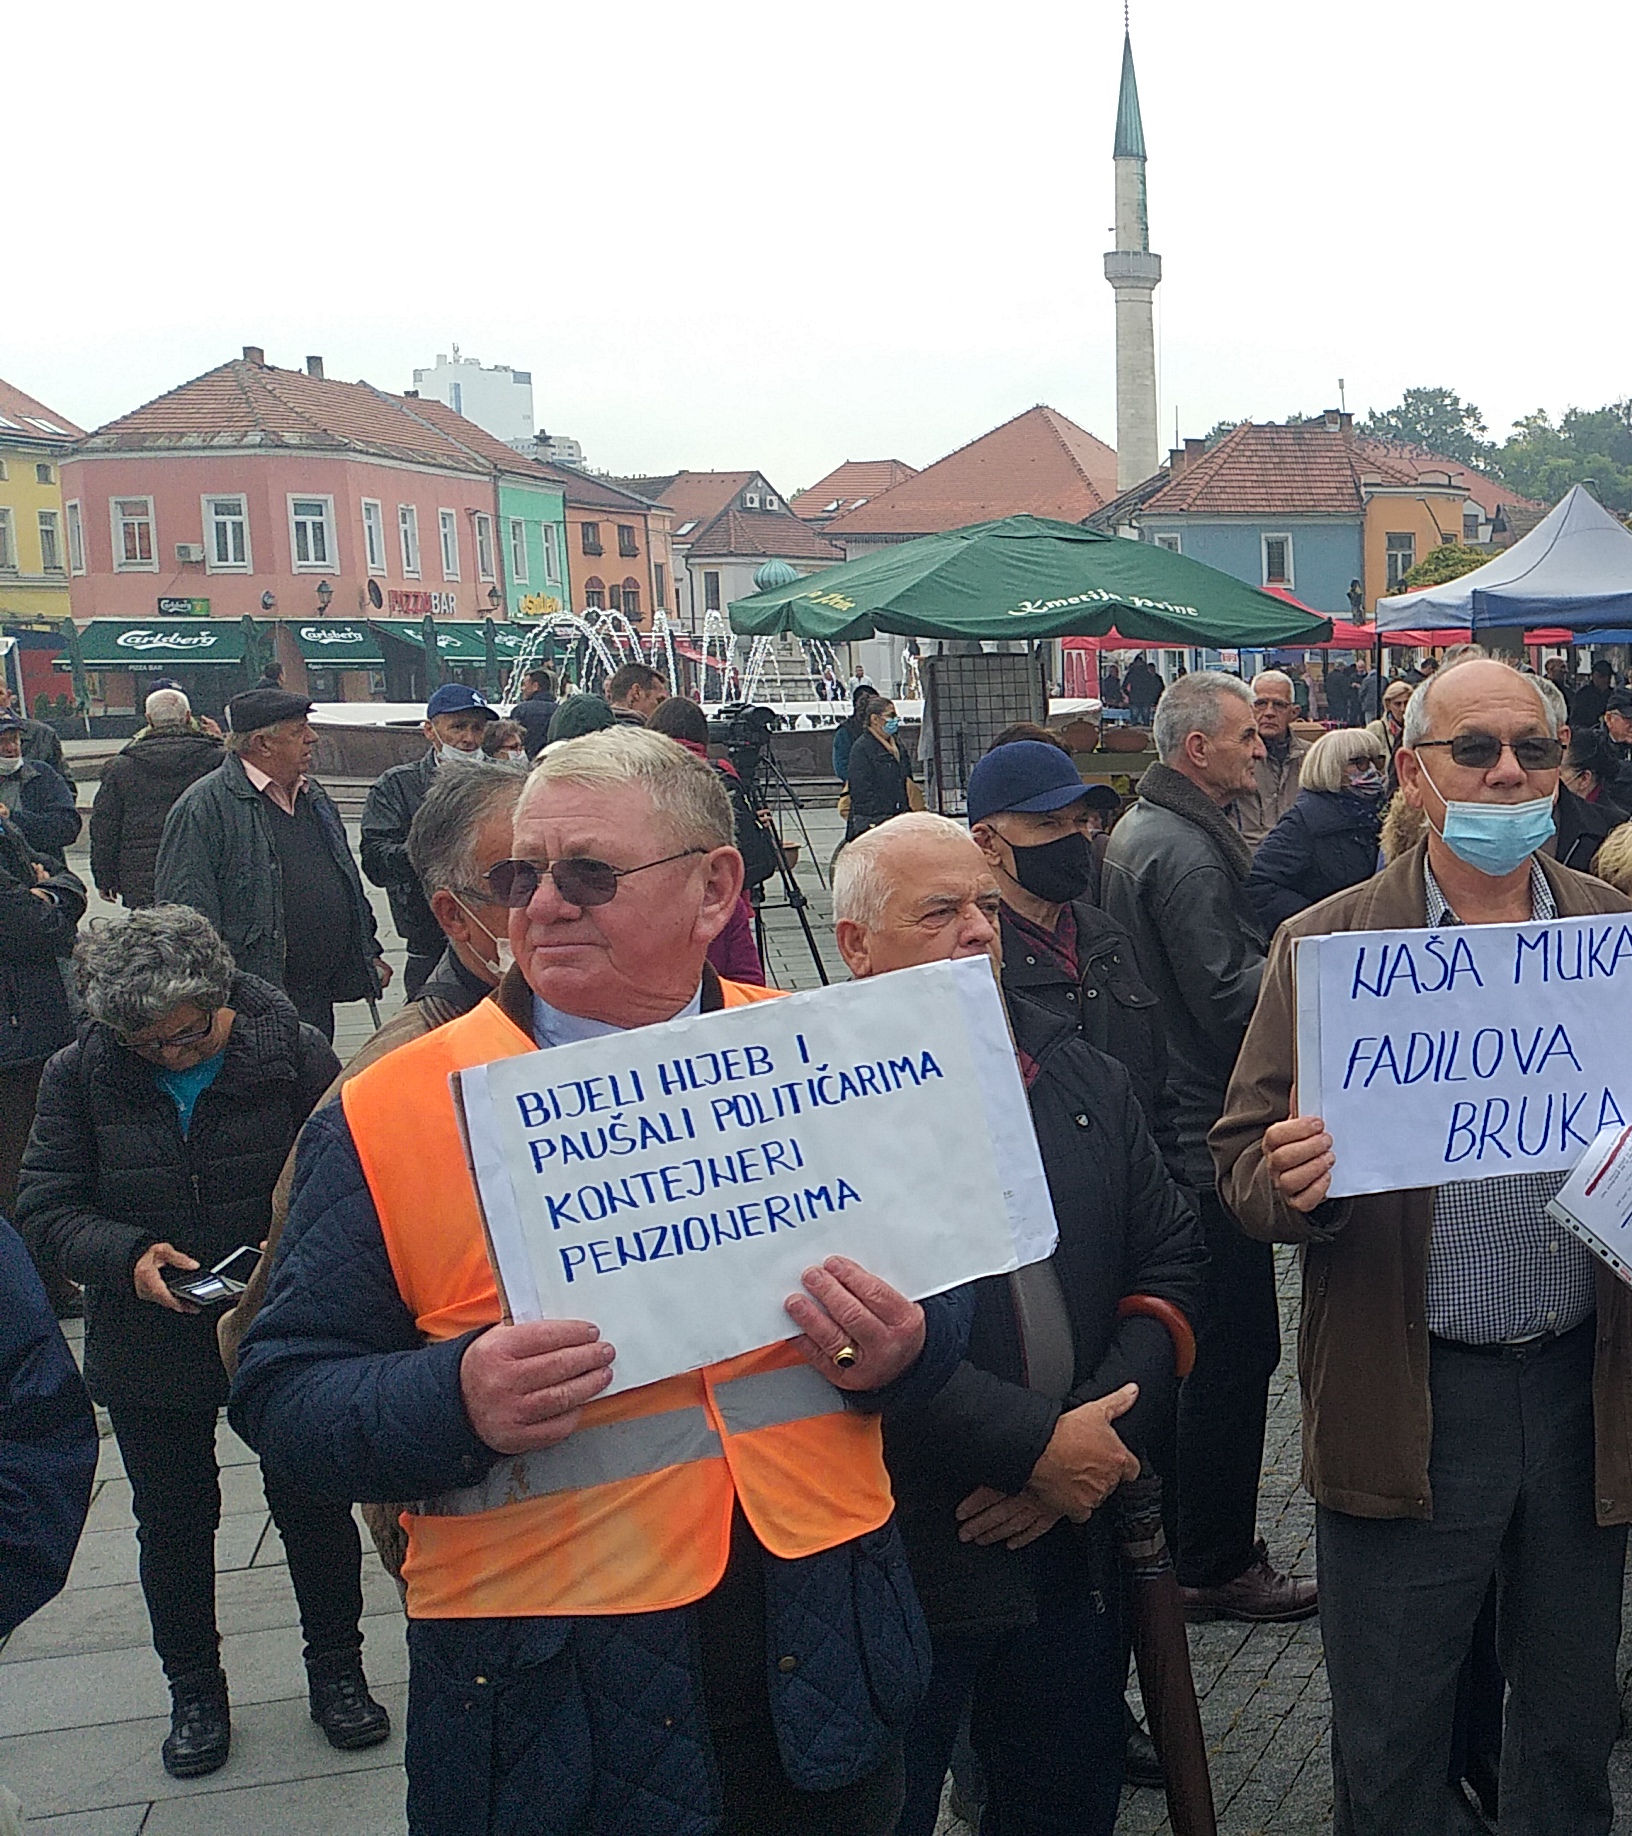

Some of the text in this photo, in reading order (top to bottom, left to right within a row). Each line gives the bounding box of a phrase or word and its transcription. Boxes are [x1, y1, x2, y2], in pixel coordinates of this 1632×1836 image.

[159, 599, 192, 613] Carlsberg
[299, 626, 364, 645] Carlsberg
[389, 590, 457, 615] PIZZA BAR
[116, 629, 218, 651] Carlsberg
[1351, 934, 1485, 1000] NAŠA
[516, 1034, 810, 1128] BIJELI HLJEB I
[1342, 1023, 1583, 1090] FADILOVA
[527, 1050, 944, 1174] PAUŠALI POLITIČARIMA
[1443, 1086, 1627, 1163] BRUKA
[544, 1137, 805, 1230] KONTEJNERI
[559, 1177, 862, 1283] PENZIONERIMA
